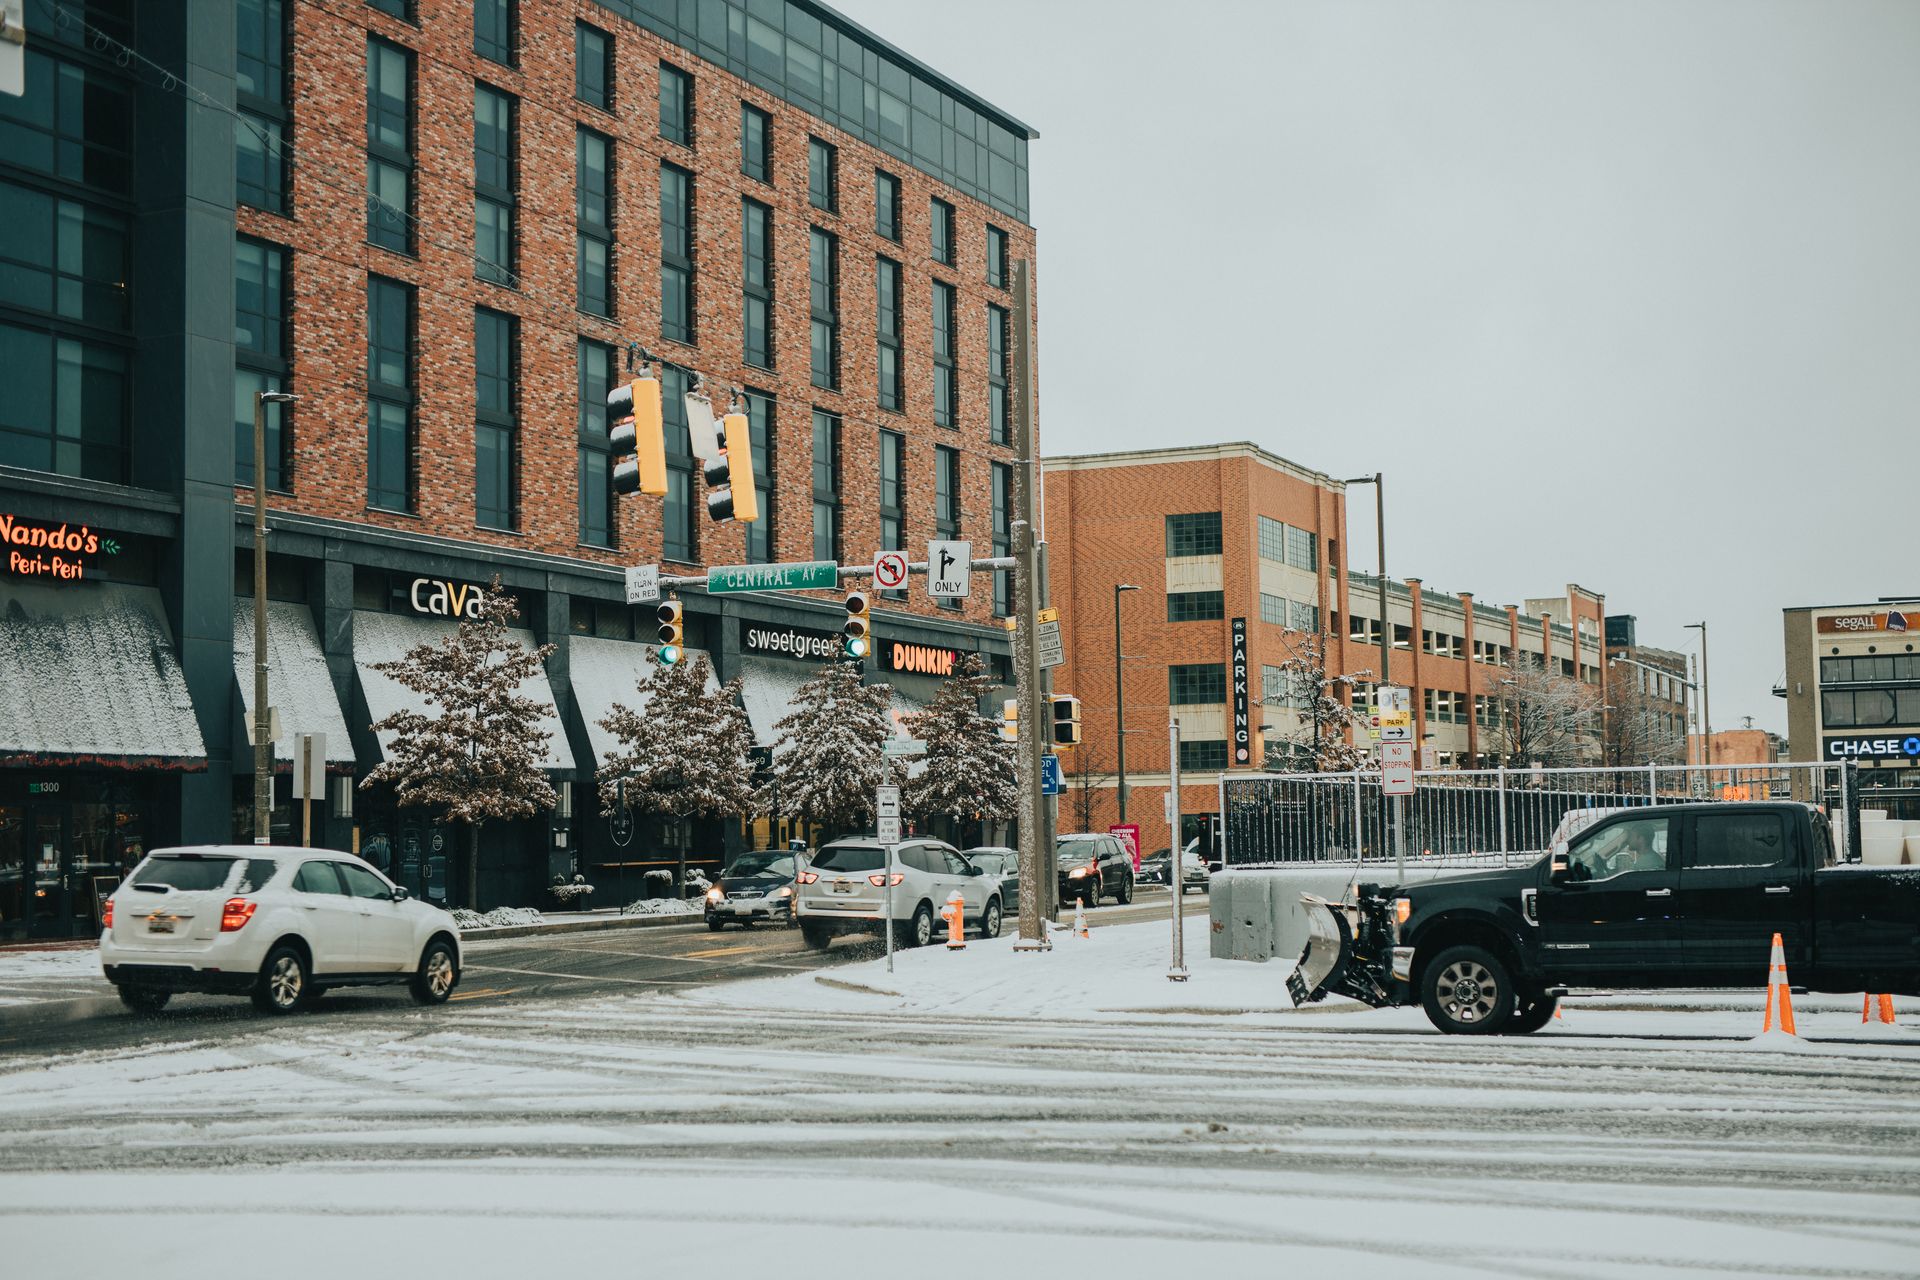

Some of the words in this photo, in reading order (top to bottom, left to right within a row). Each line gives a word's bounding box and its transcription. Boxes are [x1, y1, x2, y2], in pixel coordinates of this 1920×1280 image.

[0, 514, 98, 554] Nando's
[10, 551, 83, 579] Peri-Peri
[727, 568, 793, 588] CENTRAL
[802, 565, 817, 581] AV
[633, 579, 652, 589] TURN
[934, 581, 961, 592] ONLY
[630, 592, 640, 600] ON
[642, 589, 656, 598] RED
[1234, 634, 1248, 742] PARKING
[1391, 748, 1402, 756] NO
[1830, 739, 1900, 755] CHASE
[1384, 761, 1411, 769] STOPPING
[40, 782, 60, 792] 1300
